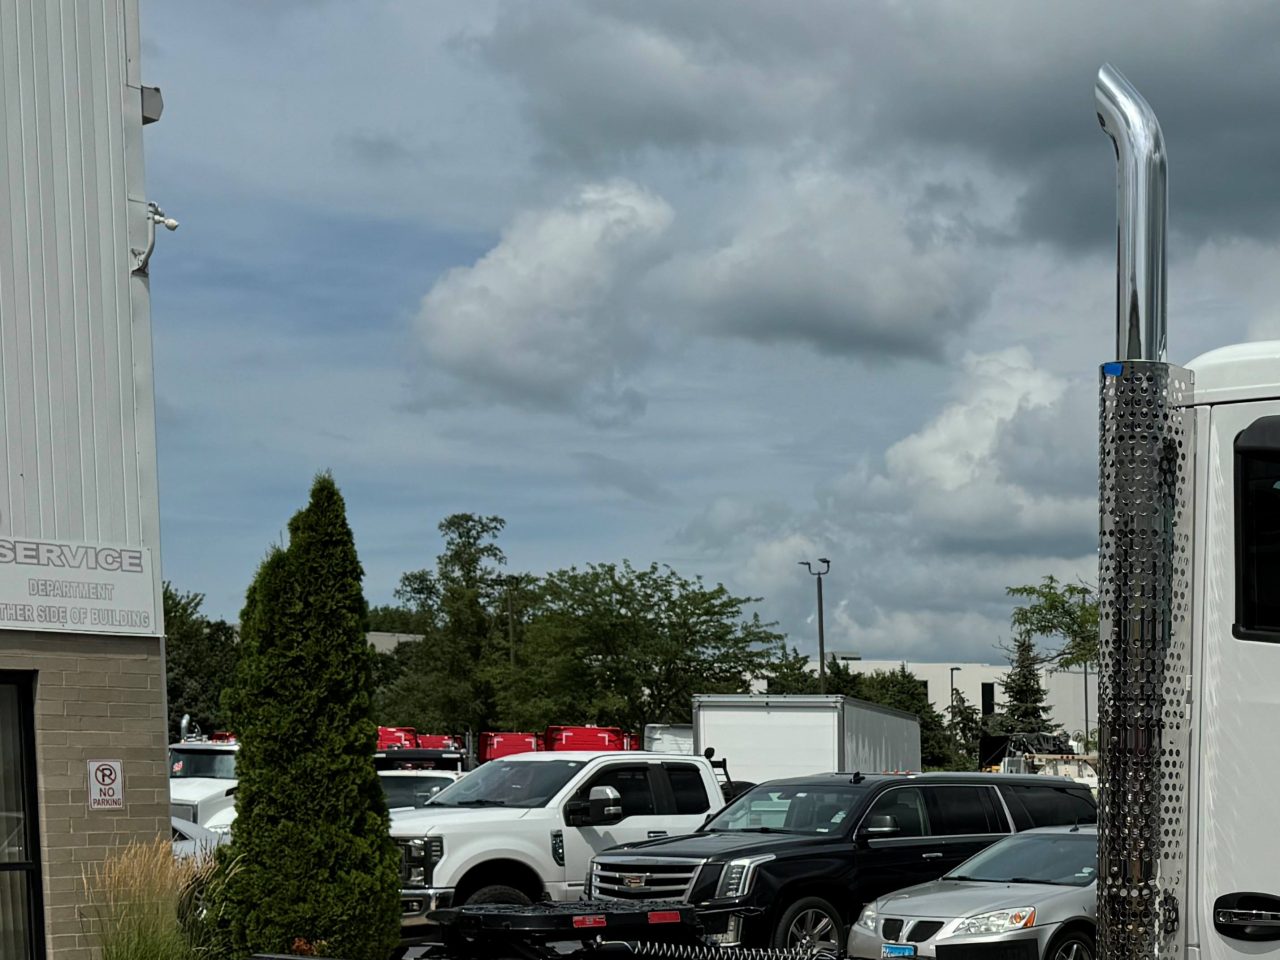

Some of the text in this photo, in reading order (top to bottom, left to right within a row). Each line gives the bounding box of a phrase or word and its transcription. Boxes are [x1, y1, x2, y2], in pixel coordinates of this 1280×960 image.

[0, 540, 143, 573] SERVICE
[28, 578, 115, 601] DEPARTMENT
[37, 604, 67, 624] SIDE
[70, 607, 89, 625] OF
[90, 608, 150, 628] BUILDING
[92, 798, 122, 807] PARKING
[99, 787, 115, 797] NO
